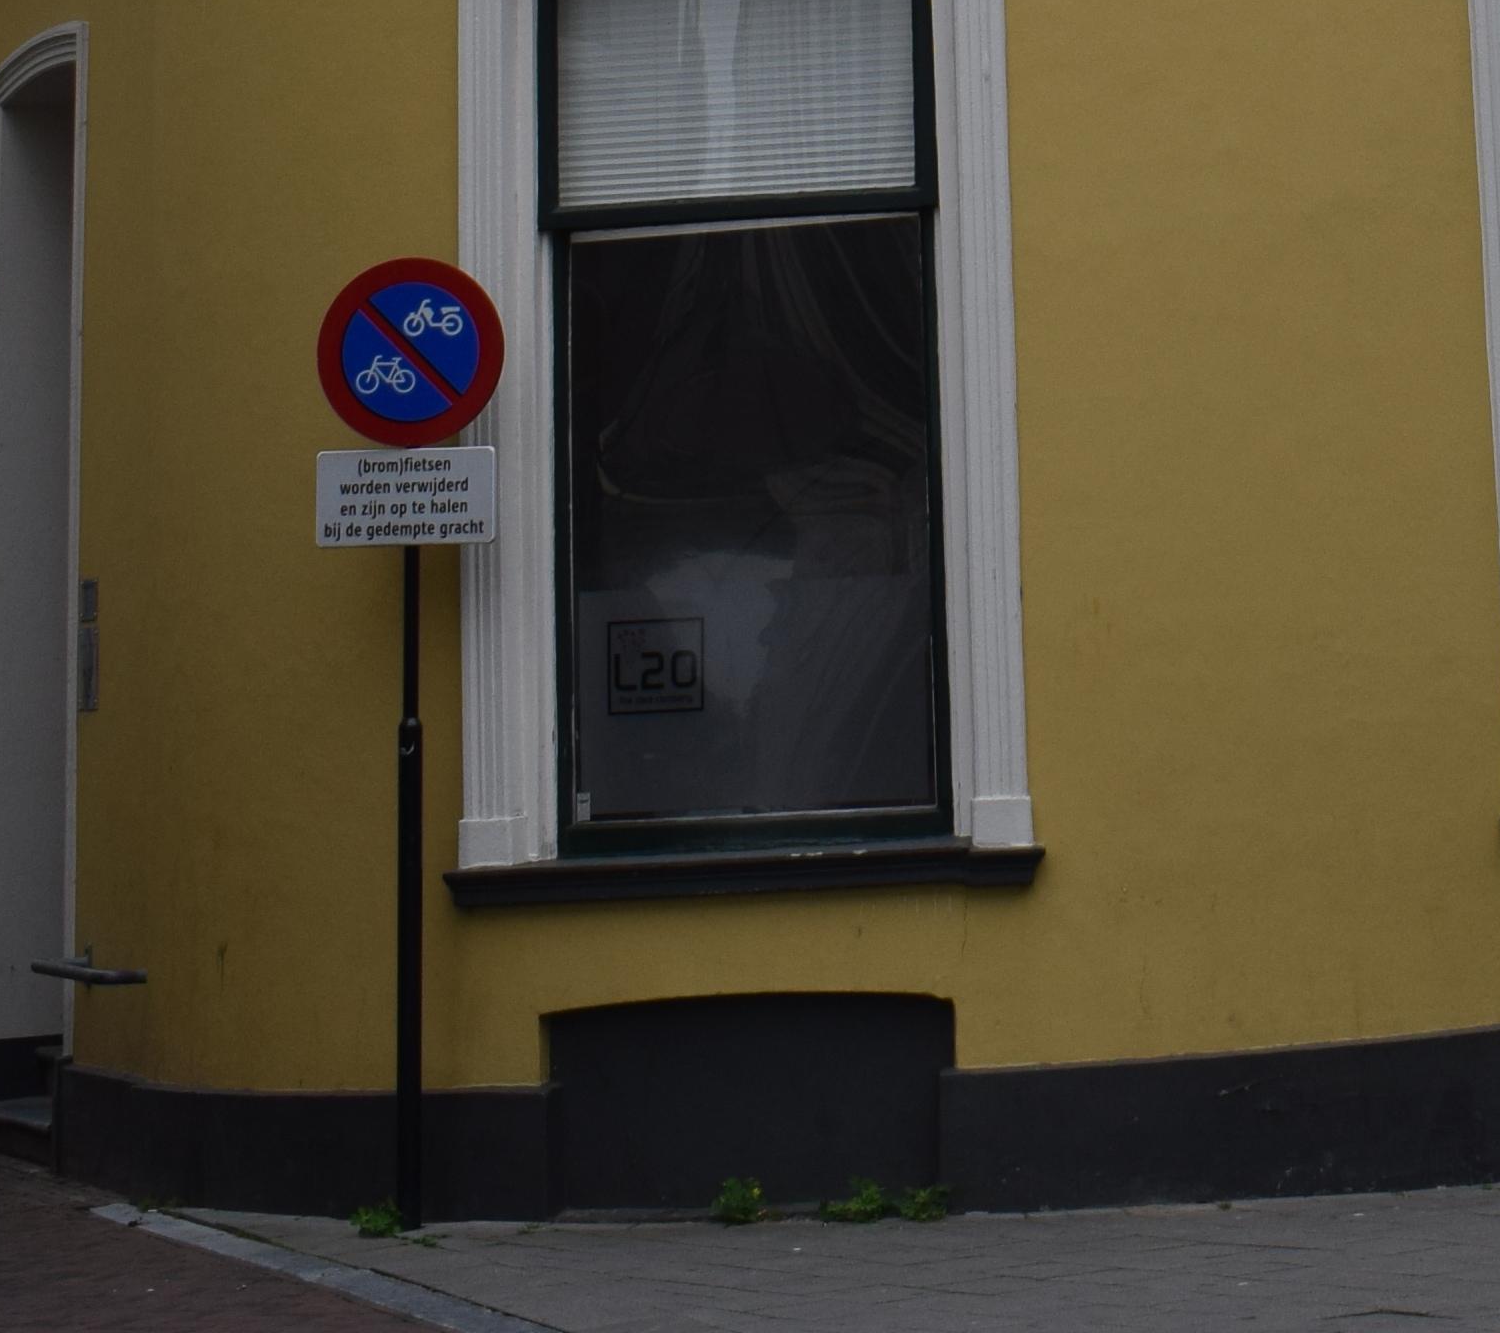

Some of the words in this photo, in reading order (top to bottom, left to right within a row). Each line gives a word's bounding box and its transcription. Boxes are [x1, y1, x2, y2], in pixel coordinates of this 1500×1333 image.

[357, 457, 451, 475] (brom)fietsen
[340, 480, 390, 495] worden
[396, 477, 469, 496] verwijderd
[340, 504, 357, 516] en
[361, 501, 386, 519] zijn
[390, 502, 407, 520] op
[412, 500, 426, 515] te
[430, 499, 468, 514] halen
[324, 523, 341, 542] bij
[346, 523, 362, 538] de
[366, 520, 435, 542] gedempte
[440, 518, 485, 539] gracht
[613, 650, 697, 691] L20
